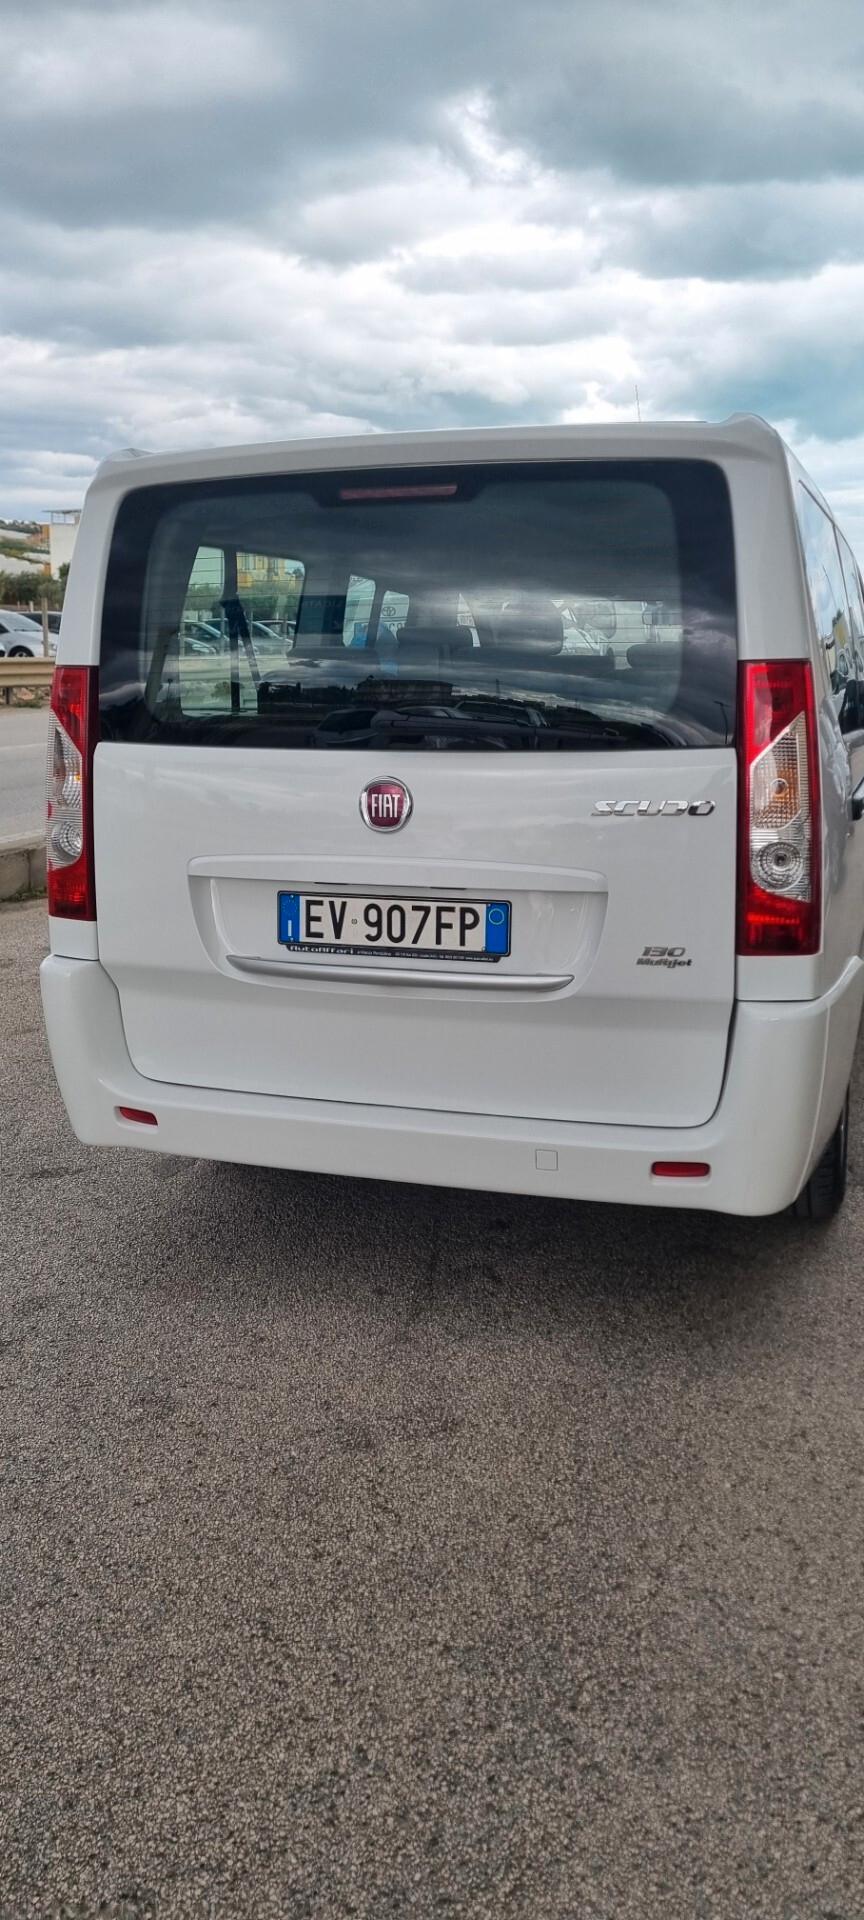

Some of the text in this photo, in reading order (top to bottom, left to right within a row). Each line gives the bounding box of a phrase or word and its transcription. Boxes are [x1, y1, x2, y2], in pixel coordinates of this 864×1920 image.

[371, 793, 401, 818] FIAT
[591, 800, 716, 817] SCUDO
[305, 899, 480, 947] EV 907FP
[642, 946, 686, 957] 130
[636, 958, 692, 969] Multijet
